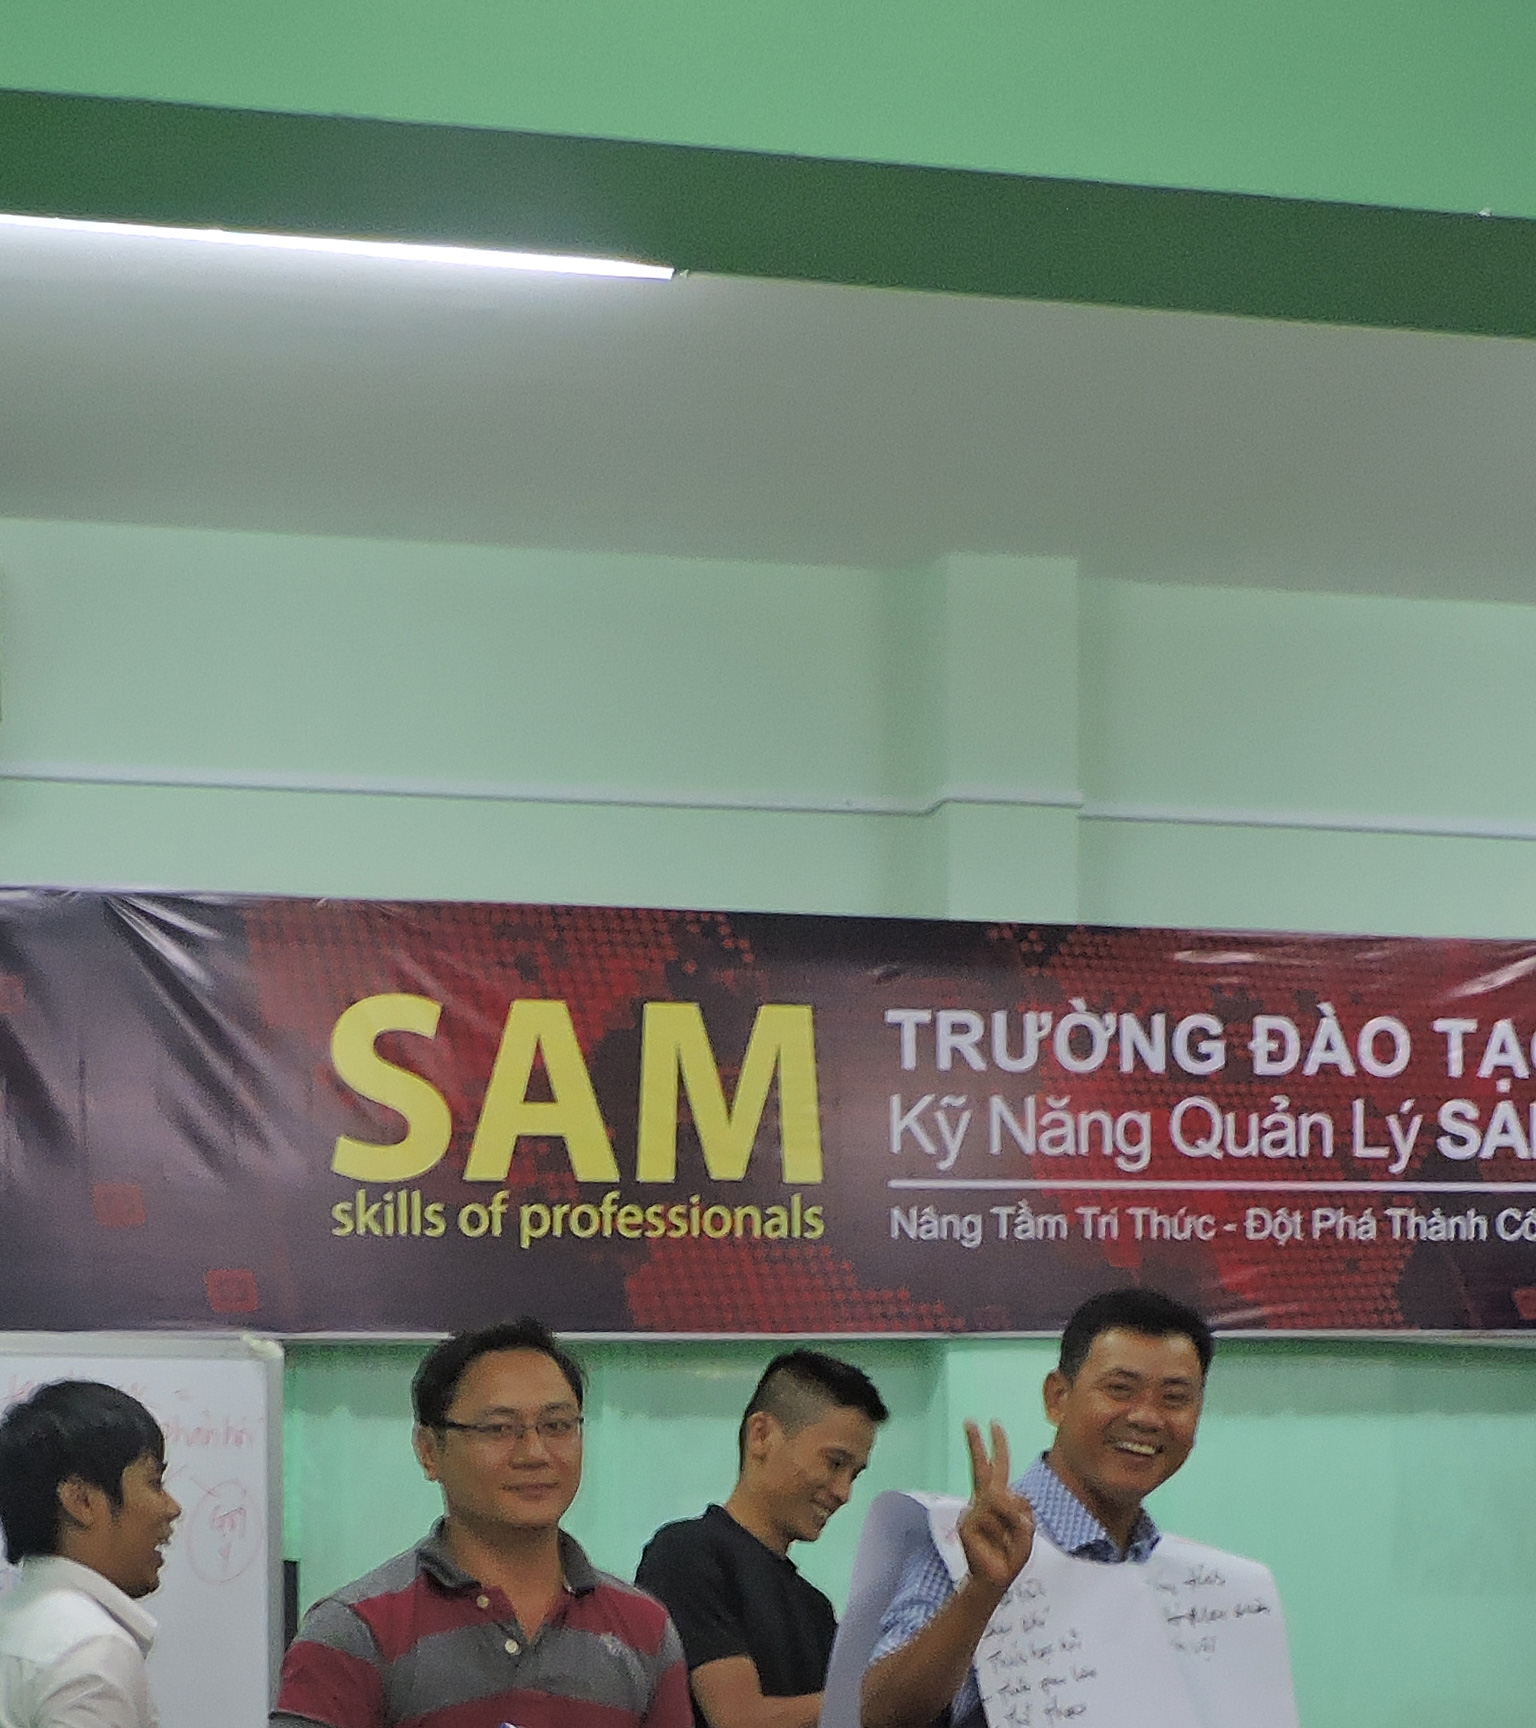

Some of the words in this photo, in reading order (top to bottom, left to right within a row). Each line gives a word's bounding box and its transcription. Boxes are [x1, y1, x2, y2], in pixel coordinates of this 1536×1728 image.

[884, 998, 1227, 1076] TRƯỜNG
[1248, 1002, 1412, 1079] ĐÀO
[330, 992, 823, 1184] SAM
[890, 1094, 972, 1170] Kỹ
[989, 1095, 1151, 1173] Năng
[1170, 1094, 1335, 1162] Quản
[1353, 1097, 1422, 1175] Lý
[330, 1190, 447, 1240] skills
[458, 1190, 510, 1240] of
[519, 1190, 824, 1249] professionals
[890, 1205, 983, 1248] Nâng
[990, 1199, 1069, 1242] Tầm
[1125, 1206, 1217, 1243] Thức
[1244, 1206, 1305, 1247] Đột
[1312, 1207, 1377, 1243] Phá
[1382, 1206, 1488, 1243] Thành
